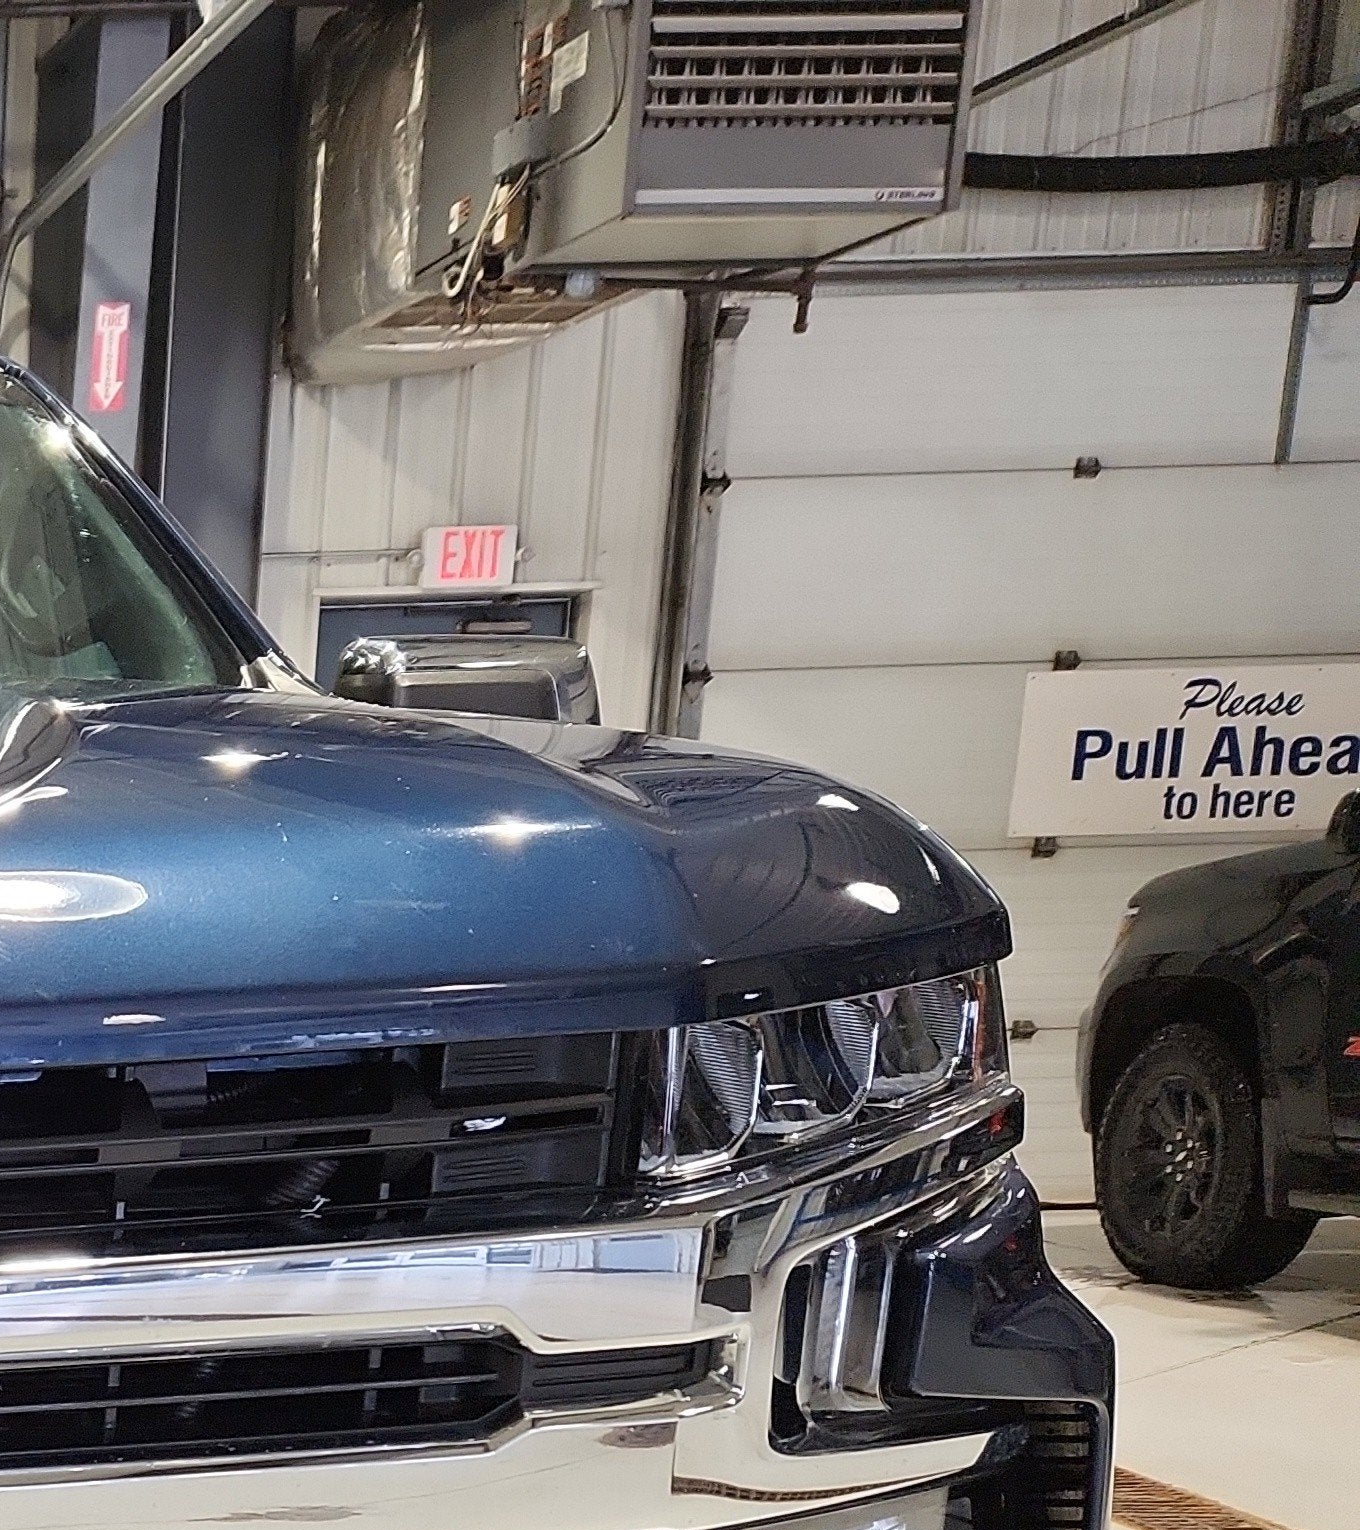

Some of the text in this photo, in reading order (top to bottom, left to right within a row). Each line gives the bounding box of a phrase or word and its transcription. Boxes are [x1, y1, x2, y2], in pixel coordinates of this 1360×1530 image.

[101, 312, 125, 327] FIRE
[440, 529, 506, 579] EXIT
[1179, 678, 1306, 720] Please
[1071, 727, 1185, 781] Pull
[1163, 783, 1296, 819] to here
